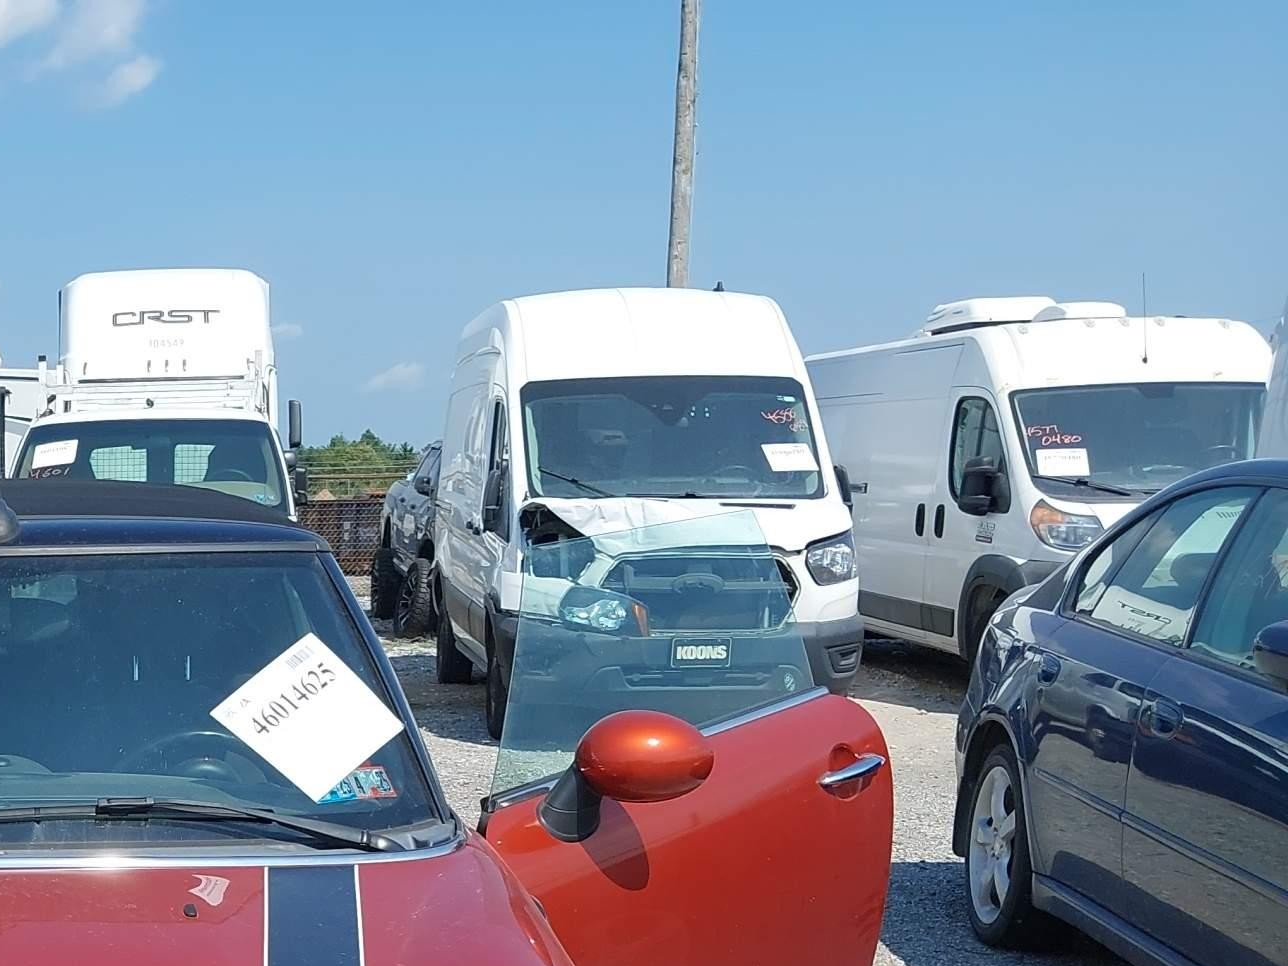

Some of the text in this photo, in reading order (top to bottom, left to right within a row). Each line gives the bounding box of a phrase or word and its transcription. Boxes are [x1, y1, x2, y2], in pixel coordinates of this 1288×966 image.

[112, 309, 220, 327] CRST
[1041, 433, 1082, 446] 0480
[676, 645, 728, 660] KOONS
[251, 662, 337, 734] 46014625
